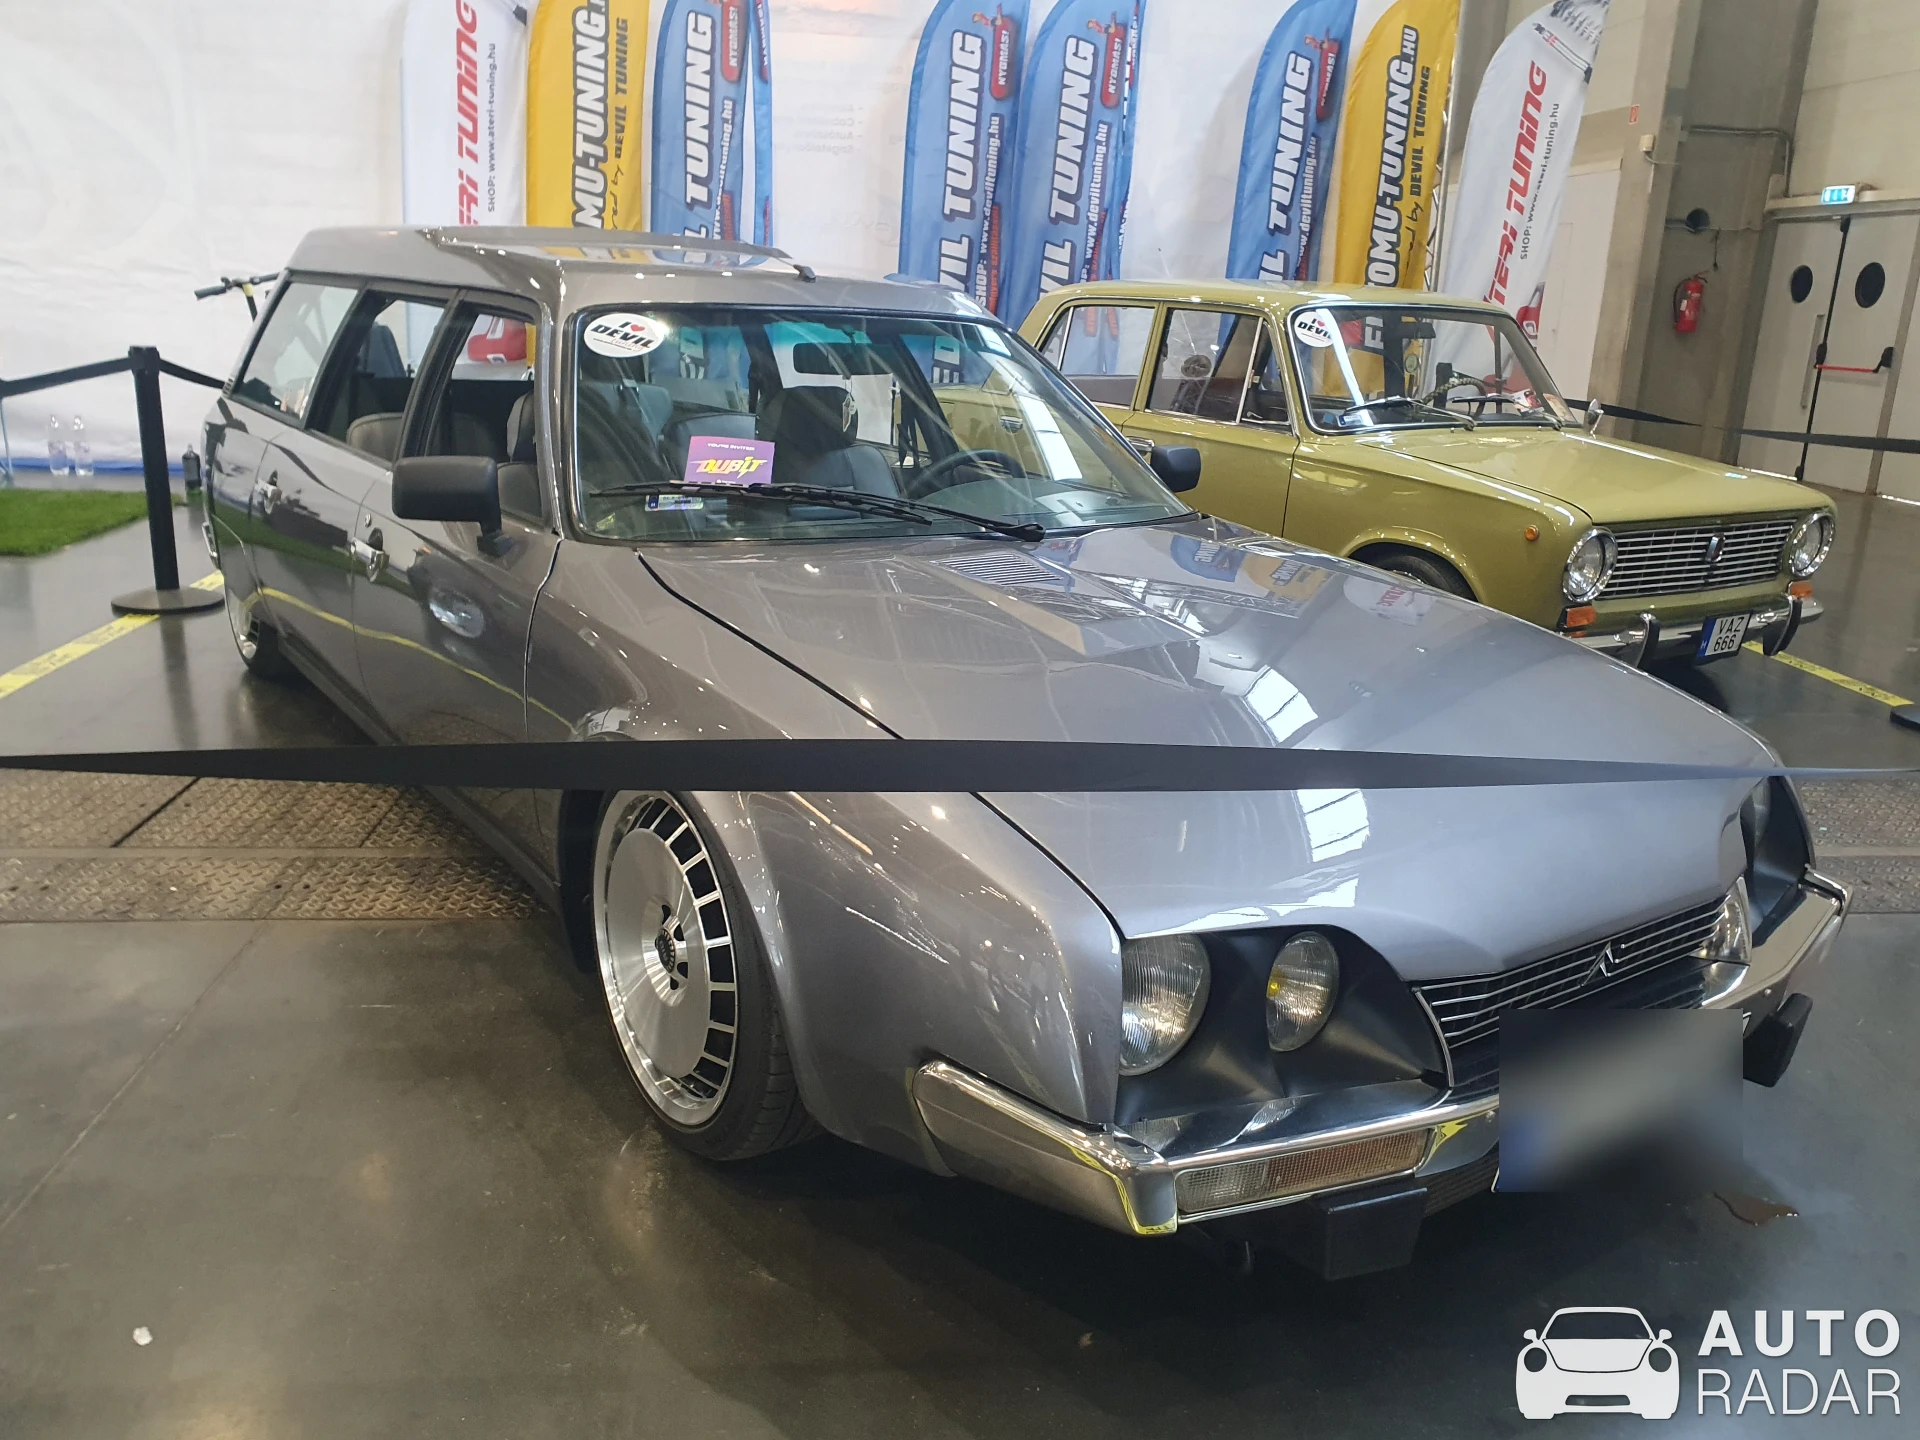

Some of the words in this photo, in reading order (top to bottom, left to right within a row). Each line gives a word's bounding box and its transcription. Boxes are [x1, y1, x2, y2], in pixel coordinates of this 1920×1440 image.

[487, 43, 497, 172] www.ateri-tuning.hu
[574, 0, 606, 228] MU-TUNING.
[615, 18, 629, 95] TUNING
[686, 12, 712, 204] TUNING
[1108, 37, 1122, 94] NYOMÁS!
[1414, 66, 1430, 138] TUNING
[615, 105, 627, 158] DEVIL
[943, 32, 984, 216] TUNING
[980, 116, 1000, 255] www.deviltuning.hu
[1050, 37, 1095, 219] TUNING
[1269, 53, 1312, 230] TUNING
[1367, 26, 1417, 287] OMU-TUNING.HU
[1410, 146, 1424, 197] DEVIL
[1520, 225, 1533, 260] SHOP:
[1527, 103, 1560, 223] www.ateri-tuning.hu
[487, 174, 496, 212] SHOP:
[1085, 123, 1108, 259] www.deviltuning.hu
[590, 324, 655, 349] DEVIL
[1713, 634, 1737, 652] 666
[1719, 616, 1745, 635] VAZ
